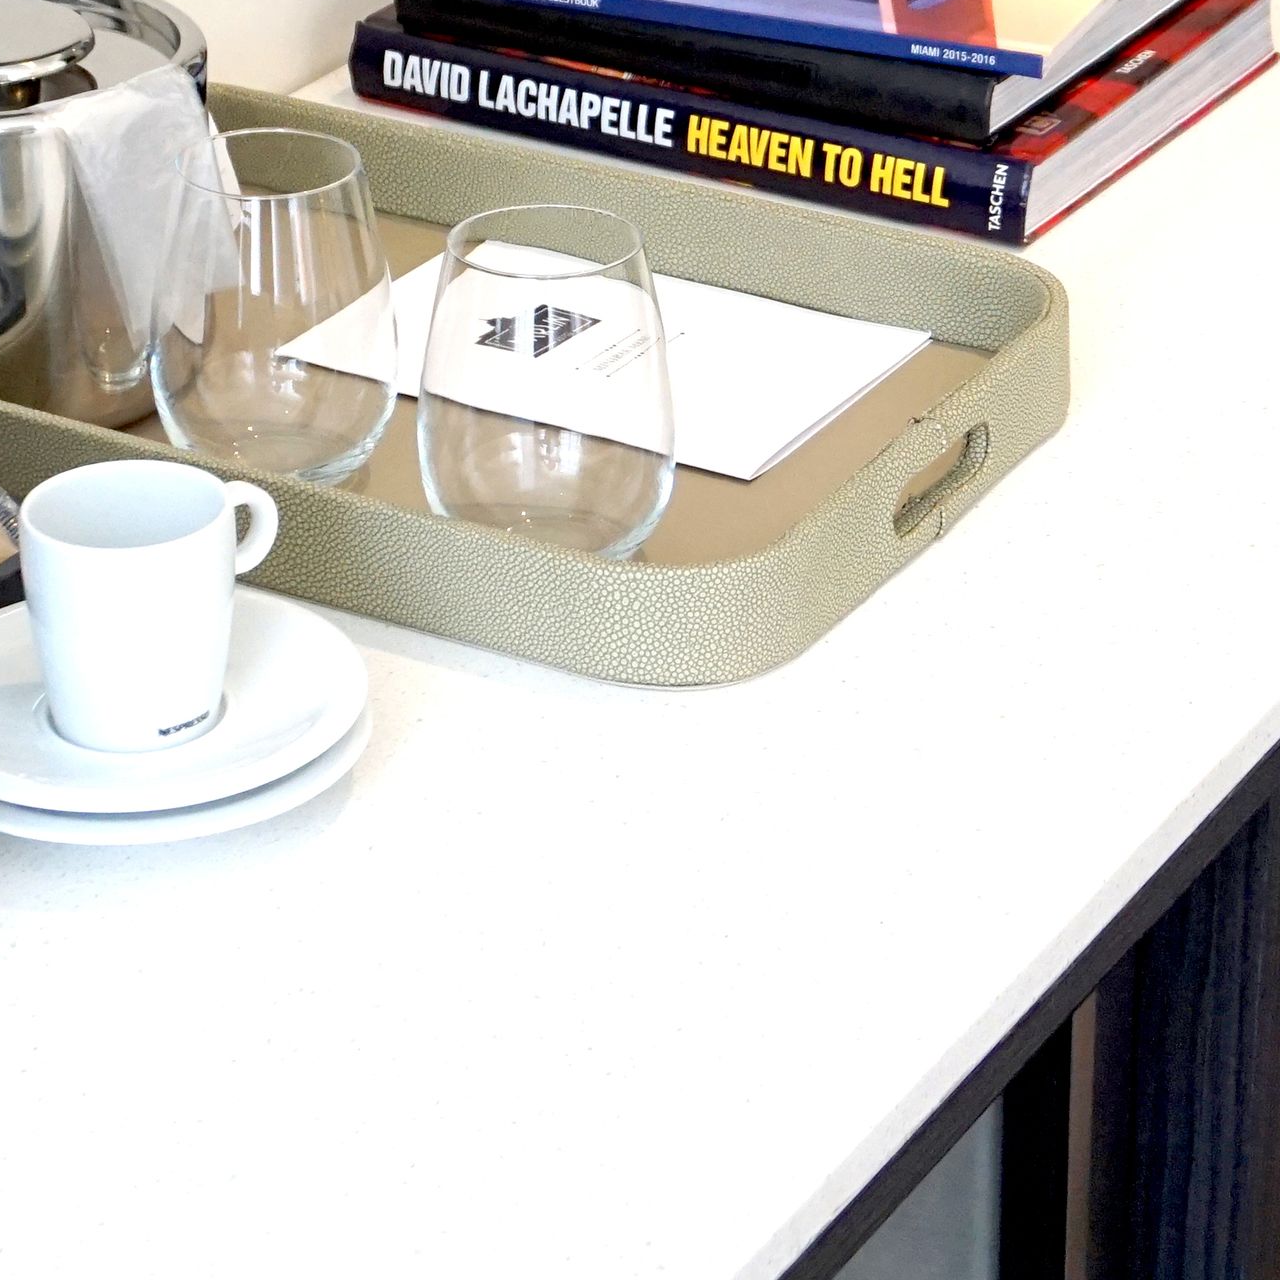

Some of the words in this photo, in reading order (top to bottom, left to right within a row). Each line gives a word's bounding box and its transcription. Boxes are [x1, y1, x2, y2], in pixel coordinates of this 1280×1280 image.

[910, 43, 940, 57] MIAMI
[942, 47, 996, 66] 2015-2016
[383, 50, 470, 102] DAVID
[478, 68, 675, 148] LACHAPELLE
[686, 114, 816, 178] HEAVEN
[822, 142, 862, 187] TO
[870, 154, 950, 208] HELL
[988, 164, 1009, 232] TASCHEN
